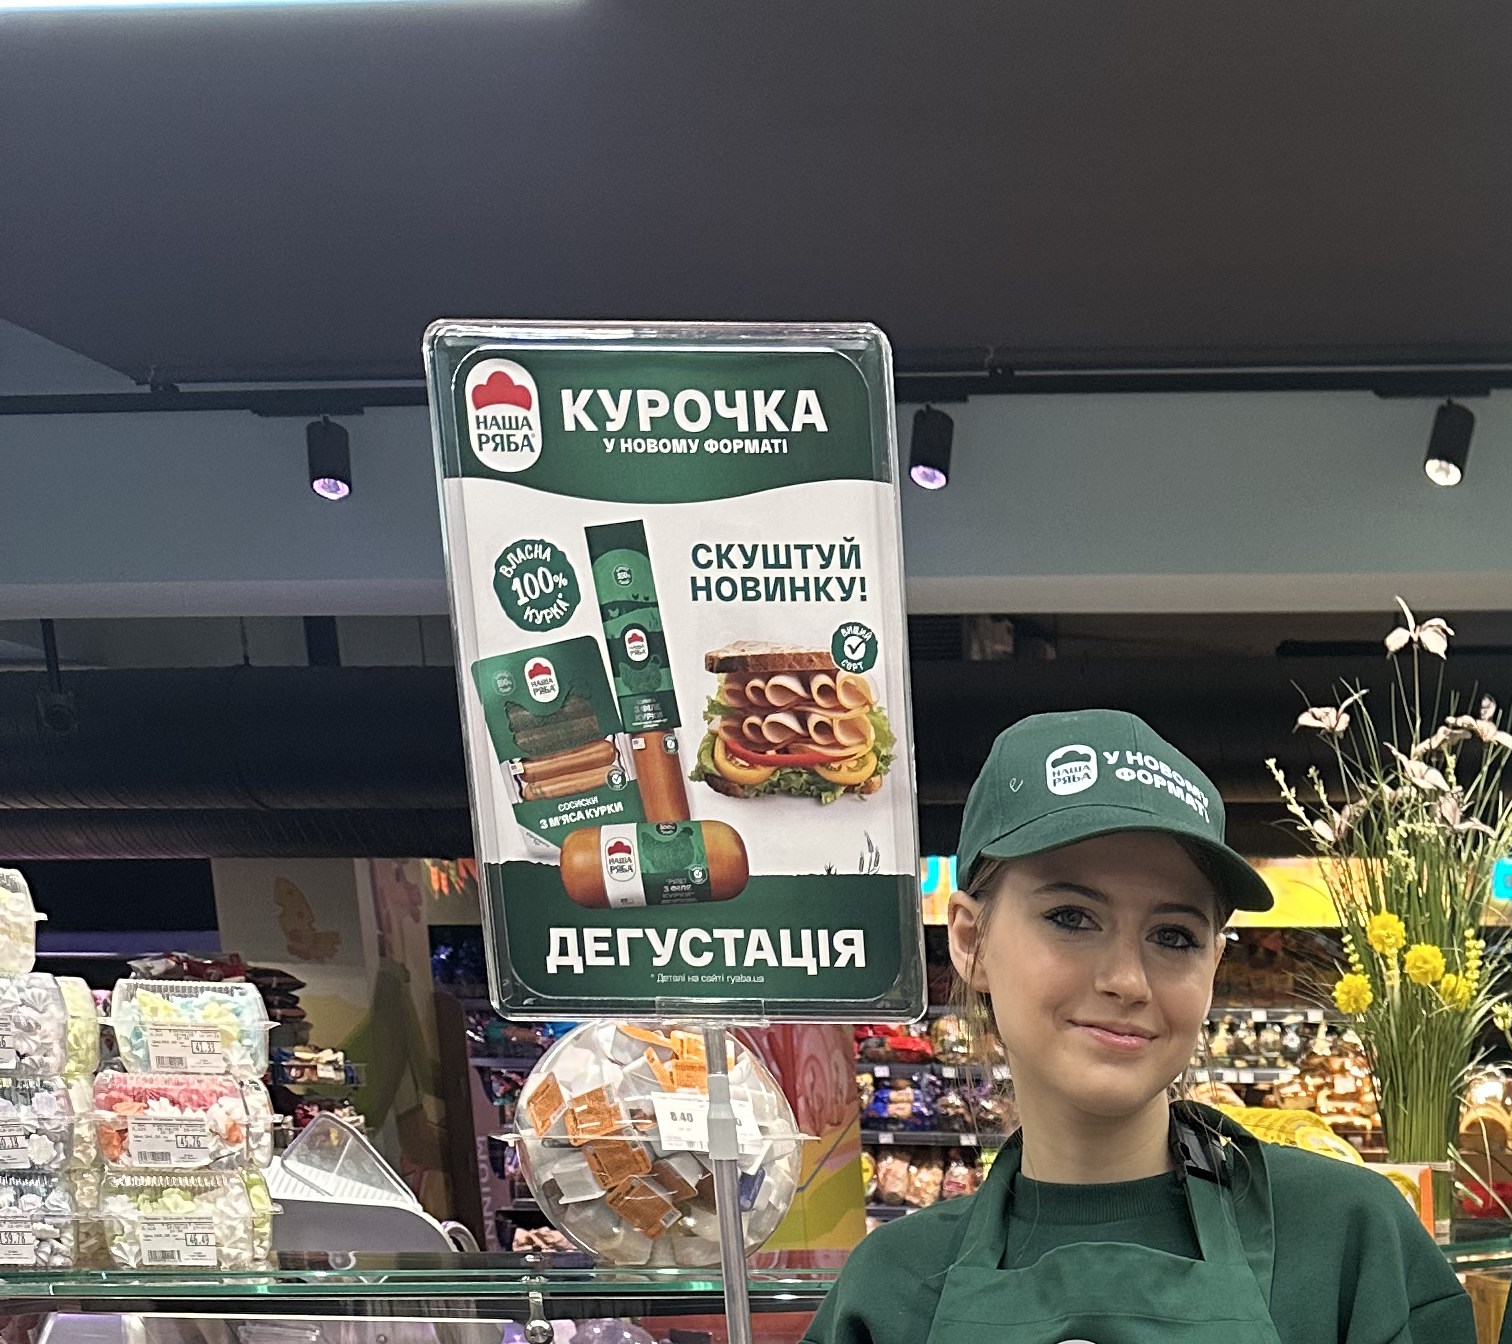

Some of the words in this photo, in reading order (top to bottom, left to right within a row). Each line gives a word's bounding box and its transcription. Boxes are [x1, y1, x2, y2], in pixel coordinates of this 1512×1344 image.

[476, 415, 533, 432] НАША
[561, 389, 829, 432] КУРОЧКА
[477, 432, 536, 453] РЯБА
[603, 438, 613, 453] У
[620, 438, 699, 454] НОВОМУ
[704, 437, 788, 454] ФОРМАТІ
[500, 544, 551, 578] ВЛАСНА
[690, 537, 862, 569] СКУШТУЙ
[512, 567, 568, 606] 100%
[690, 576, 868, 602] НОВИНКУ!
[1052, 762, 1093, 777] НАША
[1052, 773, 1092, 789] РЯБА
[1103, 750, 1120, 764] У
[1126, 750, 1209, 807] НОВОМУ
[558, 796, 598, 812] СОСИСКИ
[1115, 768, 1210, 822] ФОРМАТІ
[540, 820, 547, 829] З
[549, 812, 585, 826] М'ЯСА
[586, 802, 623, 817] КУРКИ
[546, 926, 865, 975] ДЕГУСТАЦІЯ
[670, 1112, 693, 1122] 8.40
